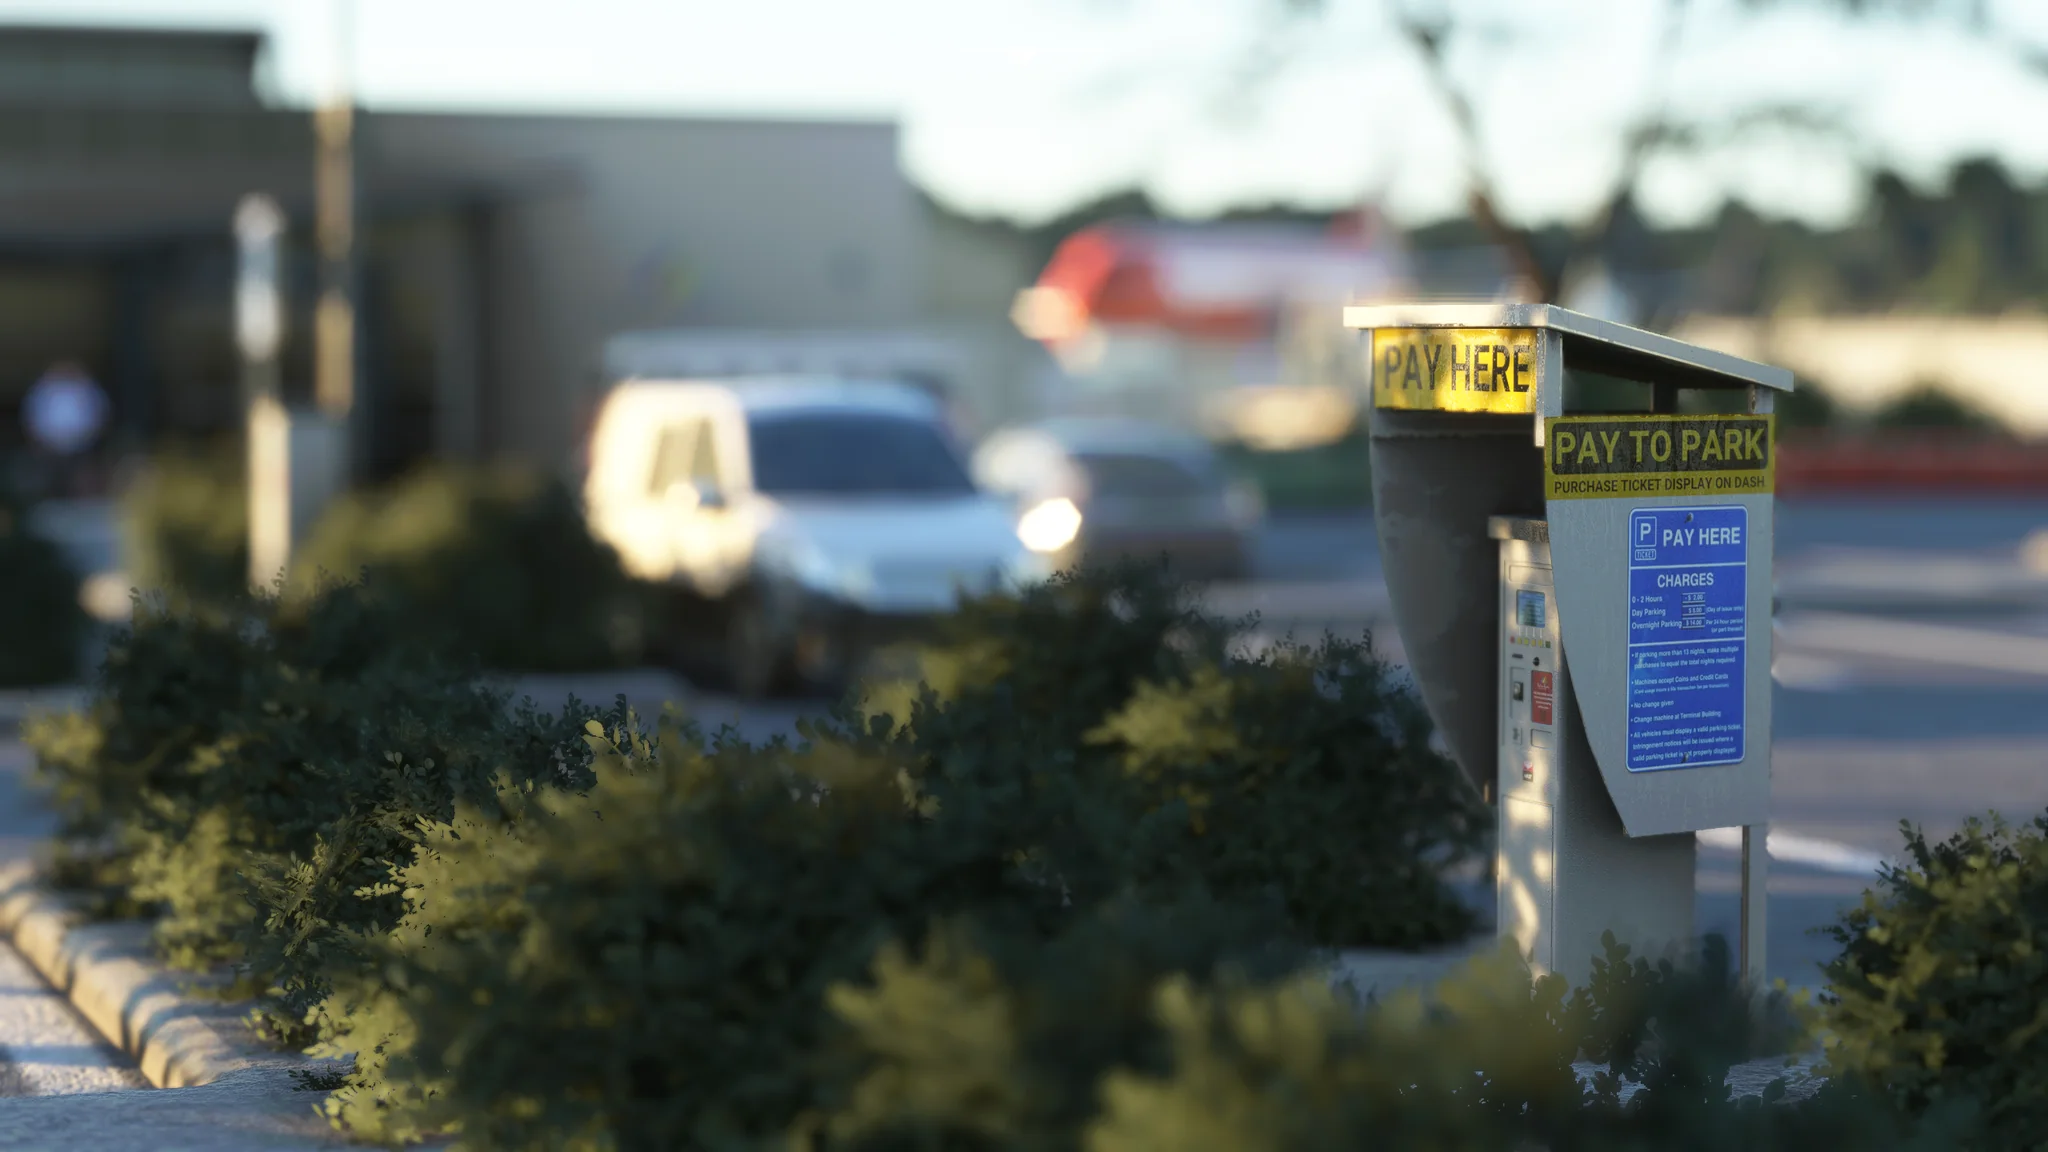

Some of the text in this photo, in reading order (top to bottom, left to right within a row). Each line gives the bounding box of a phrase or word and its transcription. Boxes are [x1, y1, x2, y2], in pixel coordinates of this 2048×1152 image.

[1384, 344, 1530, 392] PAY HERE
[1556, 428, 1764, 464] PAY TO PARK
[1554, 476, 1765, 494] PURCHASE TICKET DISPLAY ON DASH
[1640, 523, 1651, 541] P
[1663, 527, 1740, 547] PAY HERE
[1657, 573, 1714, 588] CHARGES
[1632, 609, 1643, 617] Day
[1644, 608, 1666, 616] Parking
[1632, 621, 1660, 630] Overnight
[1661, 620, 1682, 629] Parking
[1639, 651, 1657, 659] parking
[1661, 700, 1674, 708] given
[1675, 727, 1692, 735] display
[1709, 725, 1727, 733] parking
[1645, 753, 1664, 762] parking
